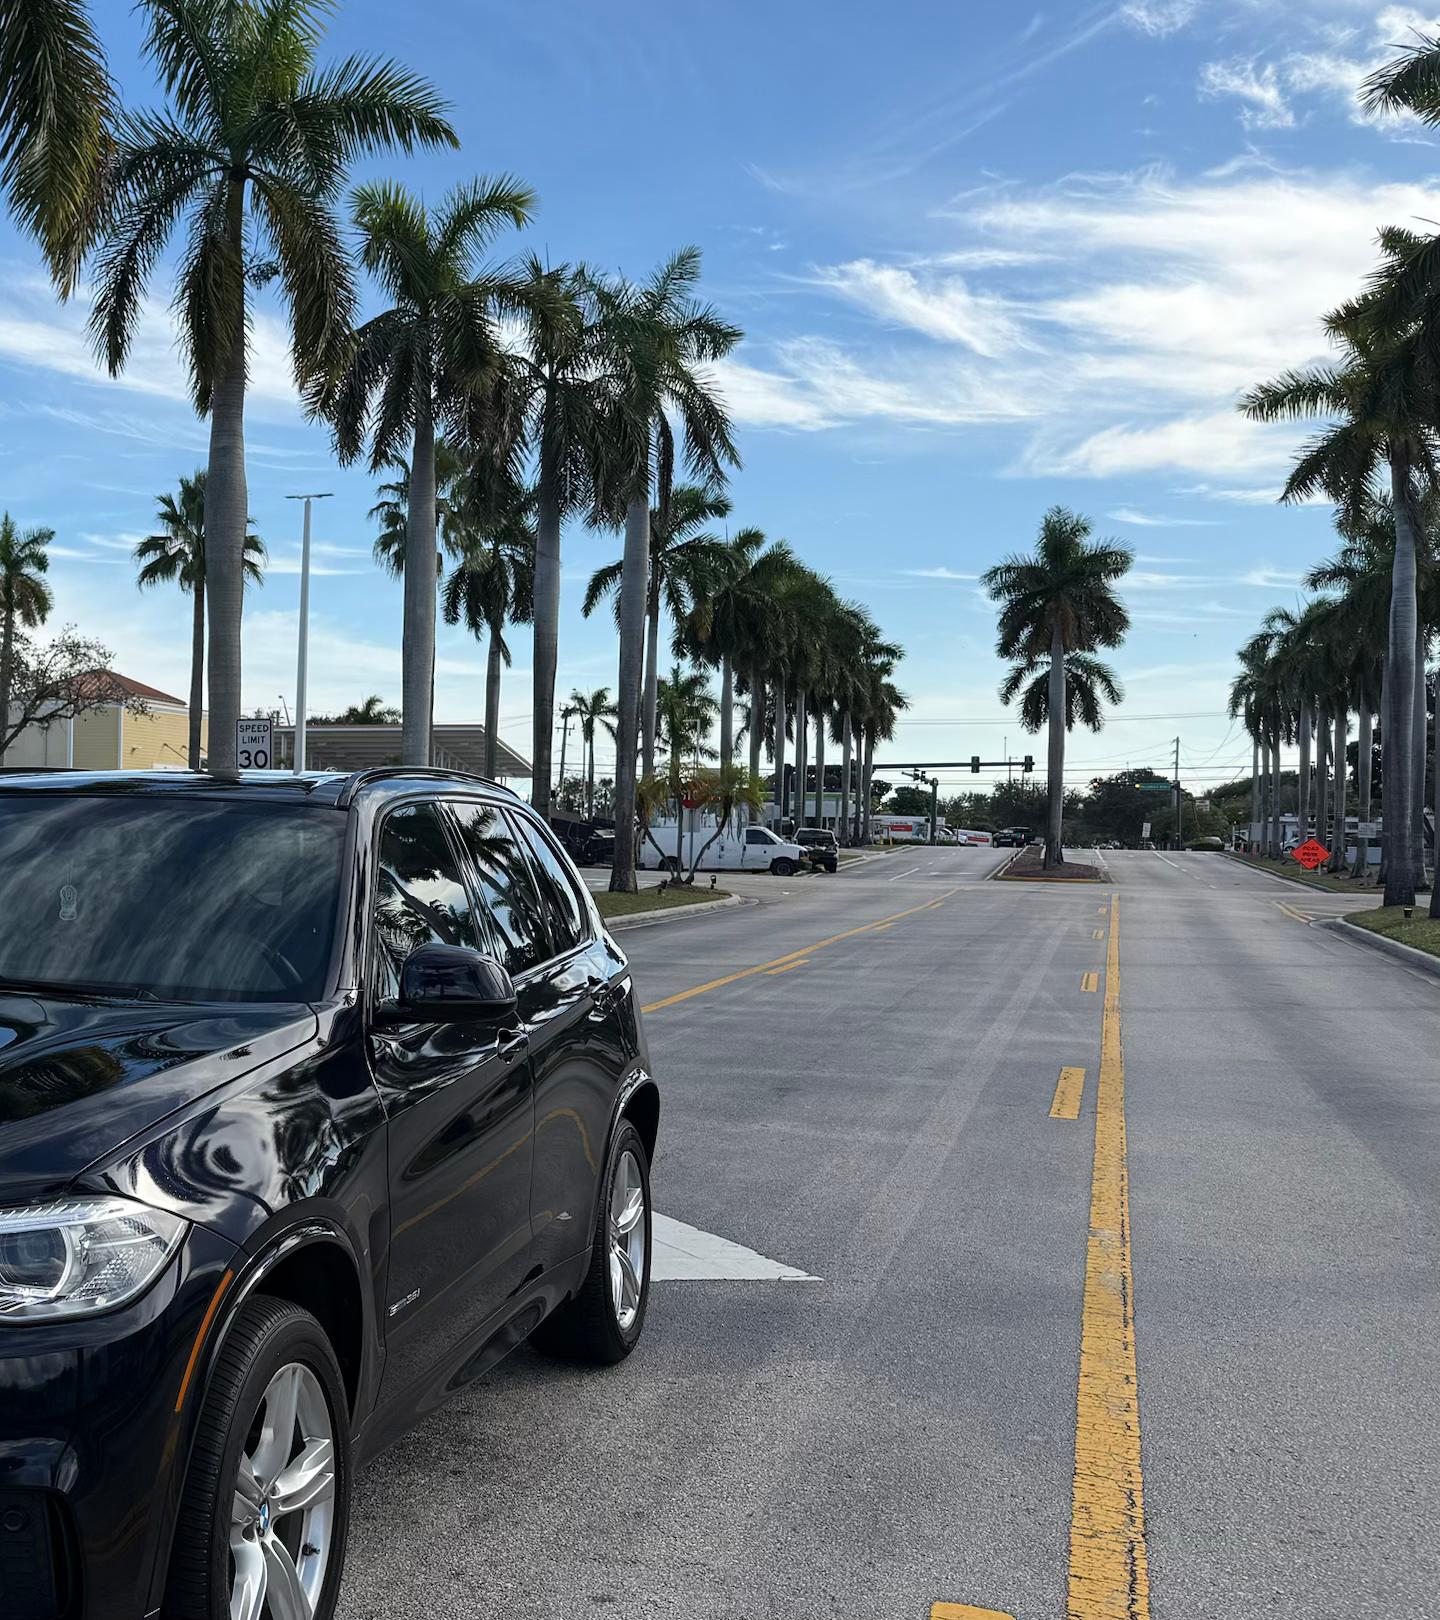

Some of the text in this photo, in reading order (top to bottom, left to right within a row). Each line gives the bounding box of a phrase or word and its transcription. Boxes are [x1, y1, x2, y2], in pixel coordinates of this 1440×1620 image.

[239, 724, 269, 733] SPEED
[242, 735, 266, 744] LIMIT
[239, 749, 268, 769] 30
